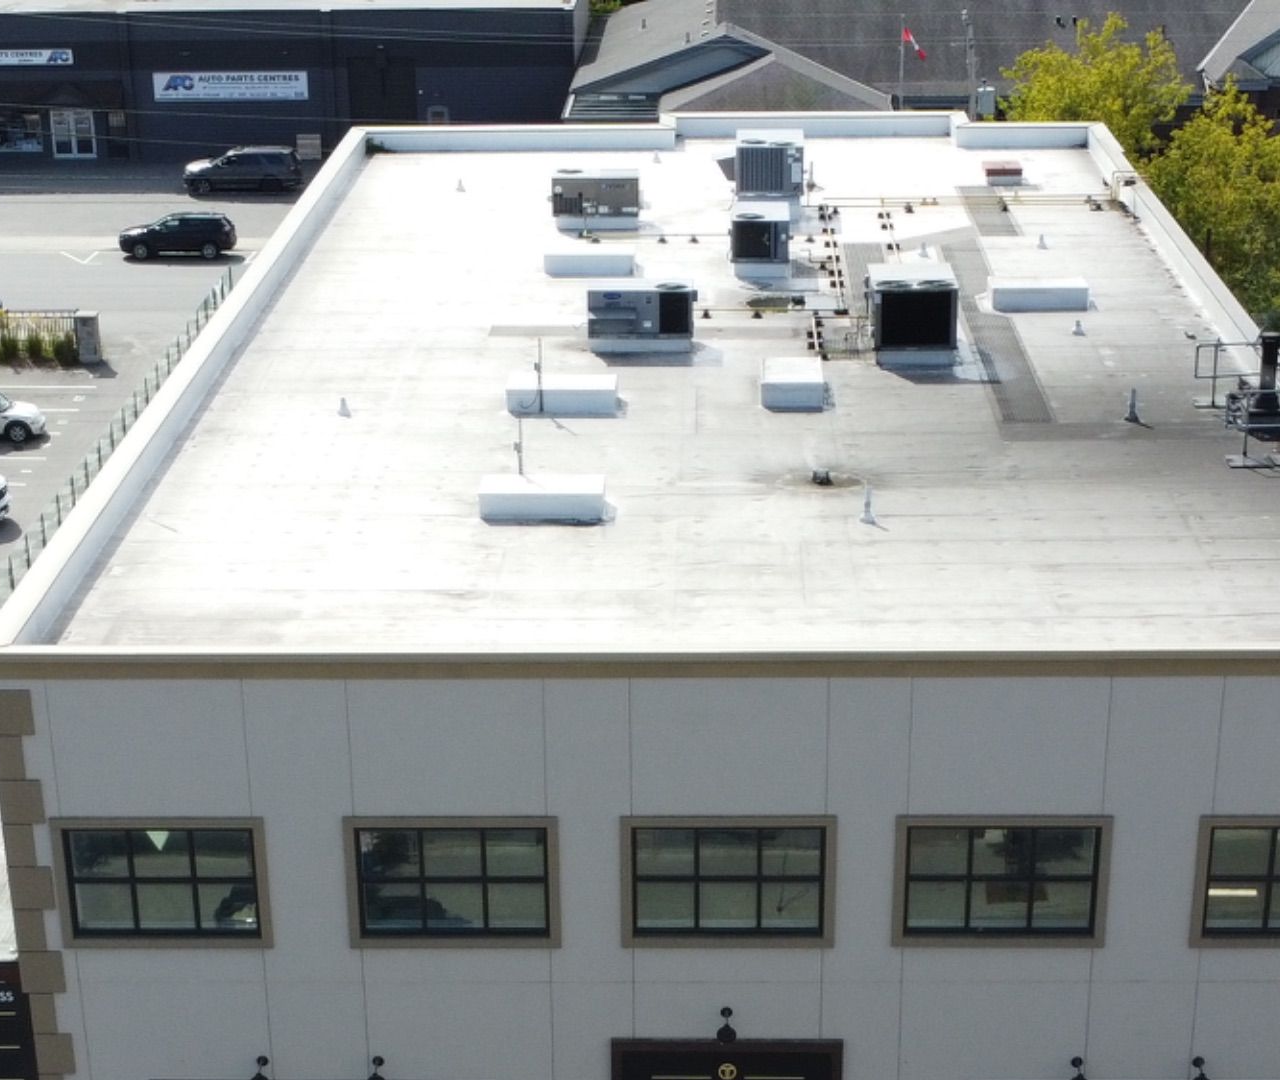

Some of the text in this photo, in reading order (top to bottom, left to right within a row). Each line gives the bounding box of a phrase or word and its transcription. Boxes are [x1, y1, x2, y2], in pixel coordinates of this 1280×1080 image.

[198, 74, 300, 82] AUTO PARTS CENTRES
